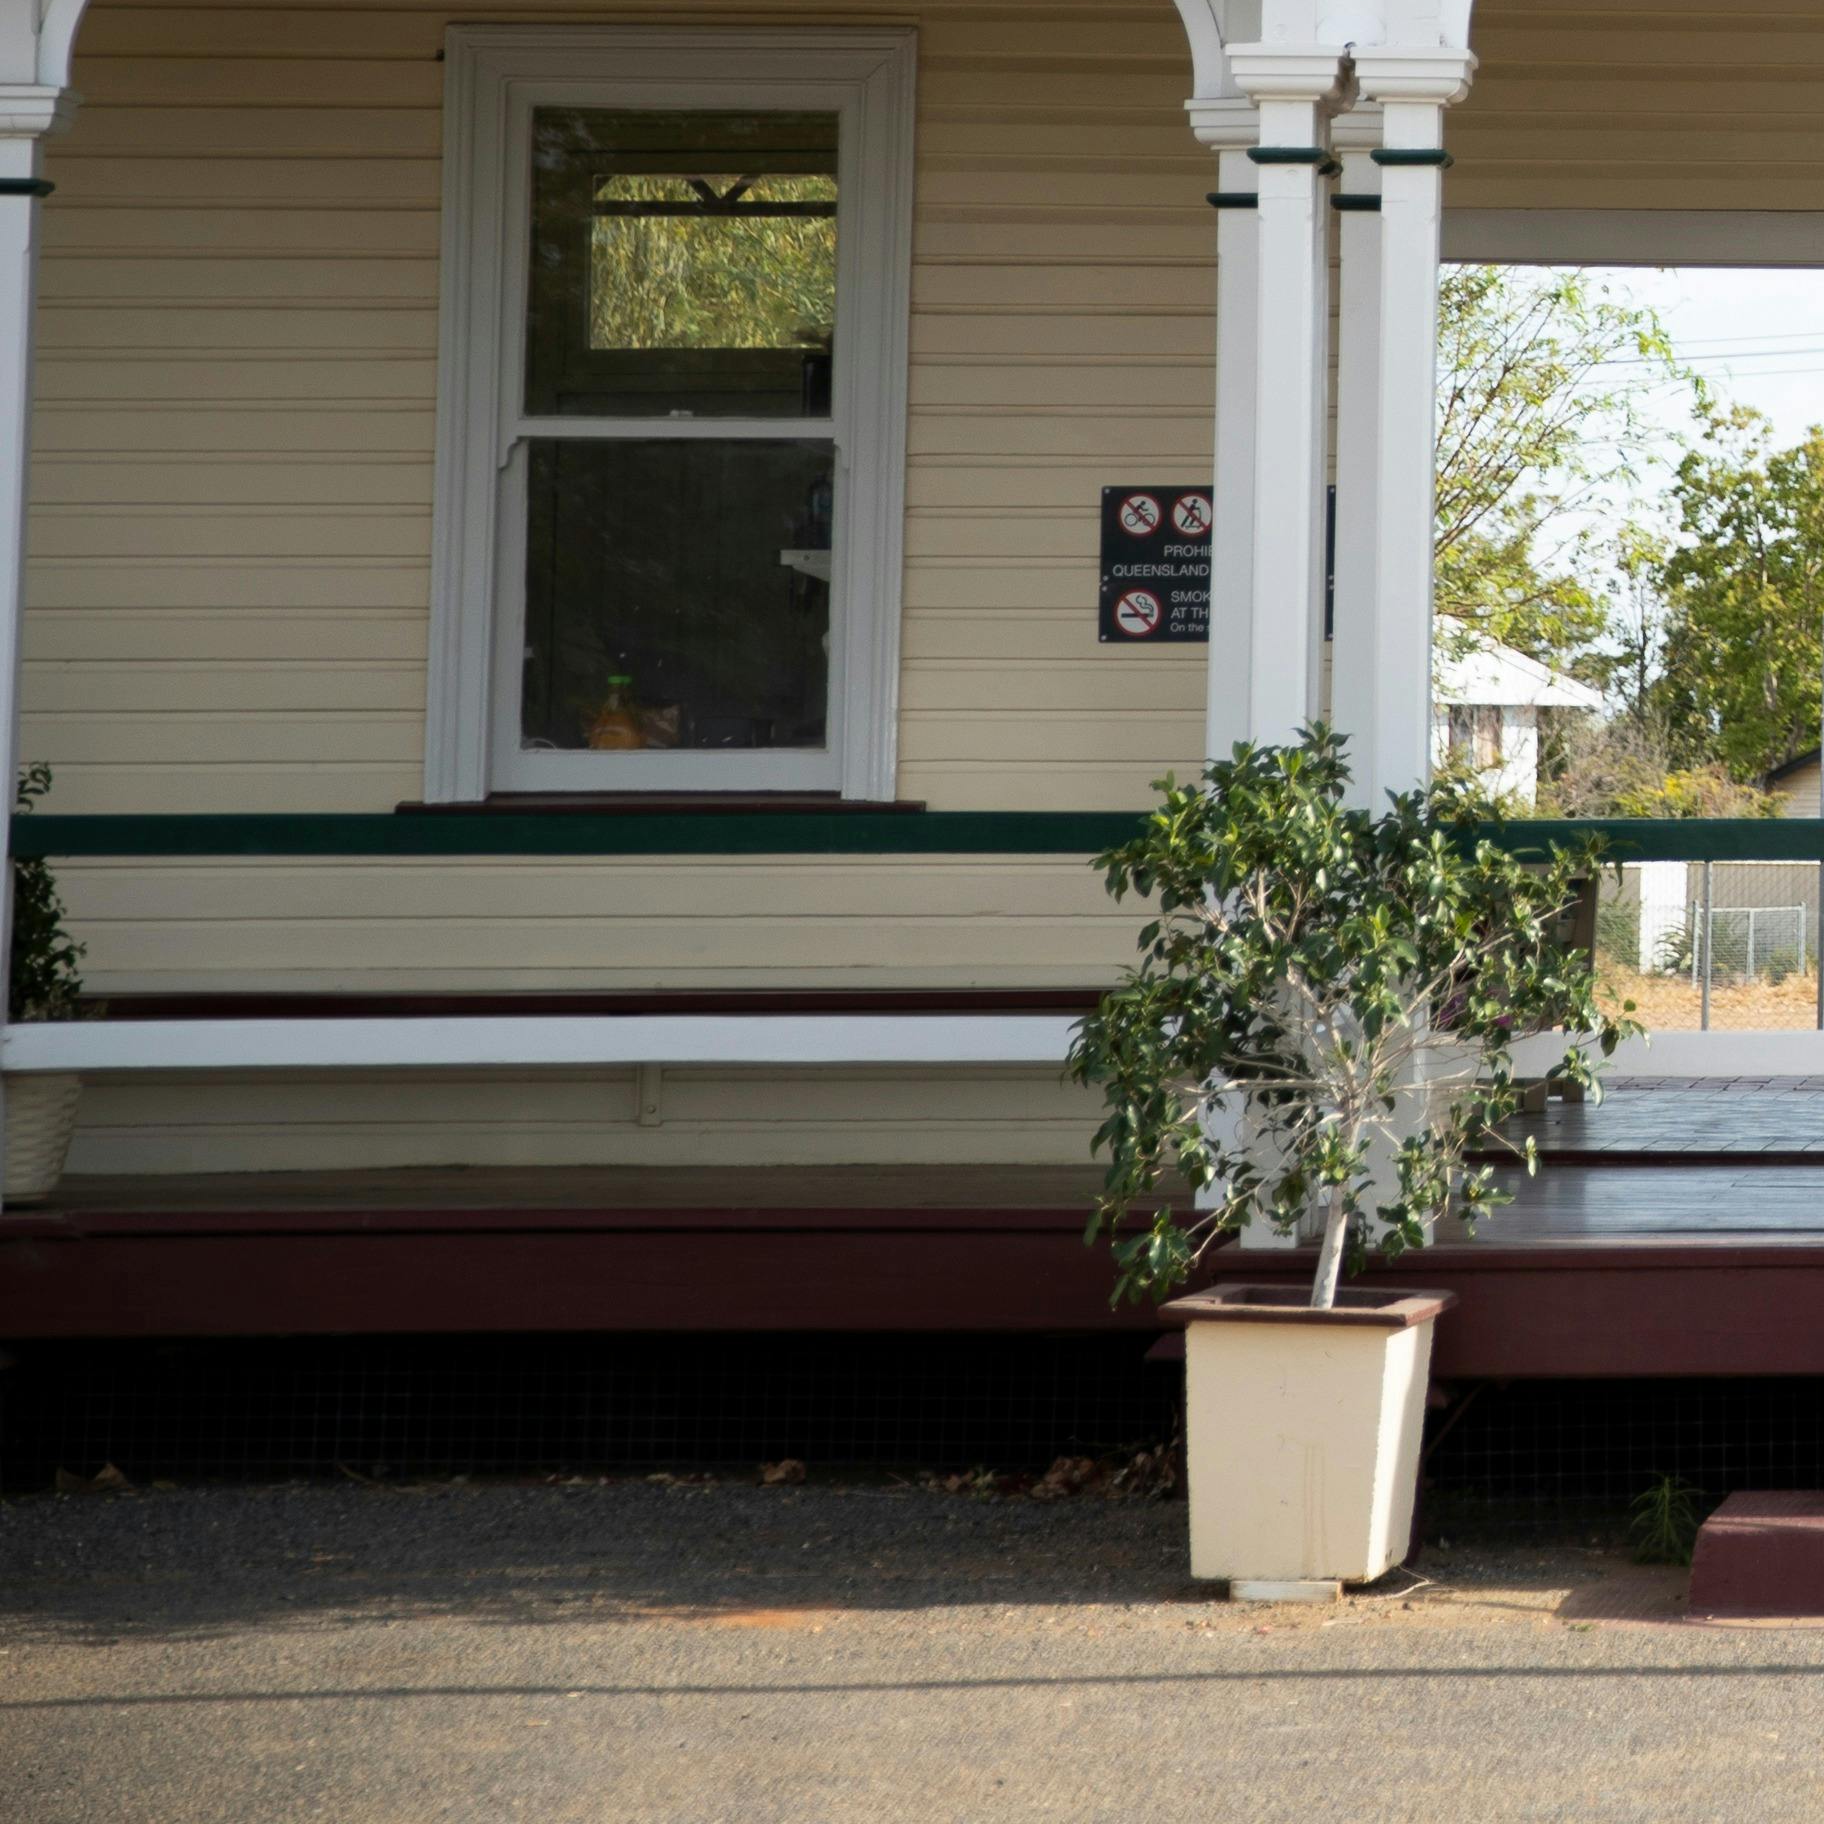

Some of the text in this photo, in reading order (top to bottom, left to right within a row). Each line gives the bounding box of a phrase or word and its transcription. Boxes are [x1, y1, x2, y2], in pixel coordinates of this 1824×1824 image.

[1112, 564, 1210, 577] QUEENSLAND
[1170, 607, 1187, 619] AT
[1170, 622, 1185, 633] On
[1188, 622, 1204, 633] the
